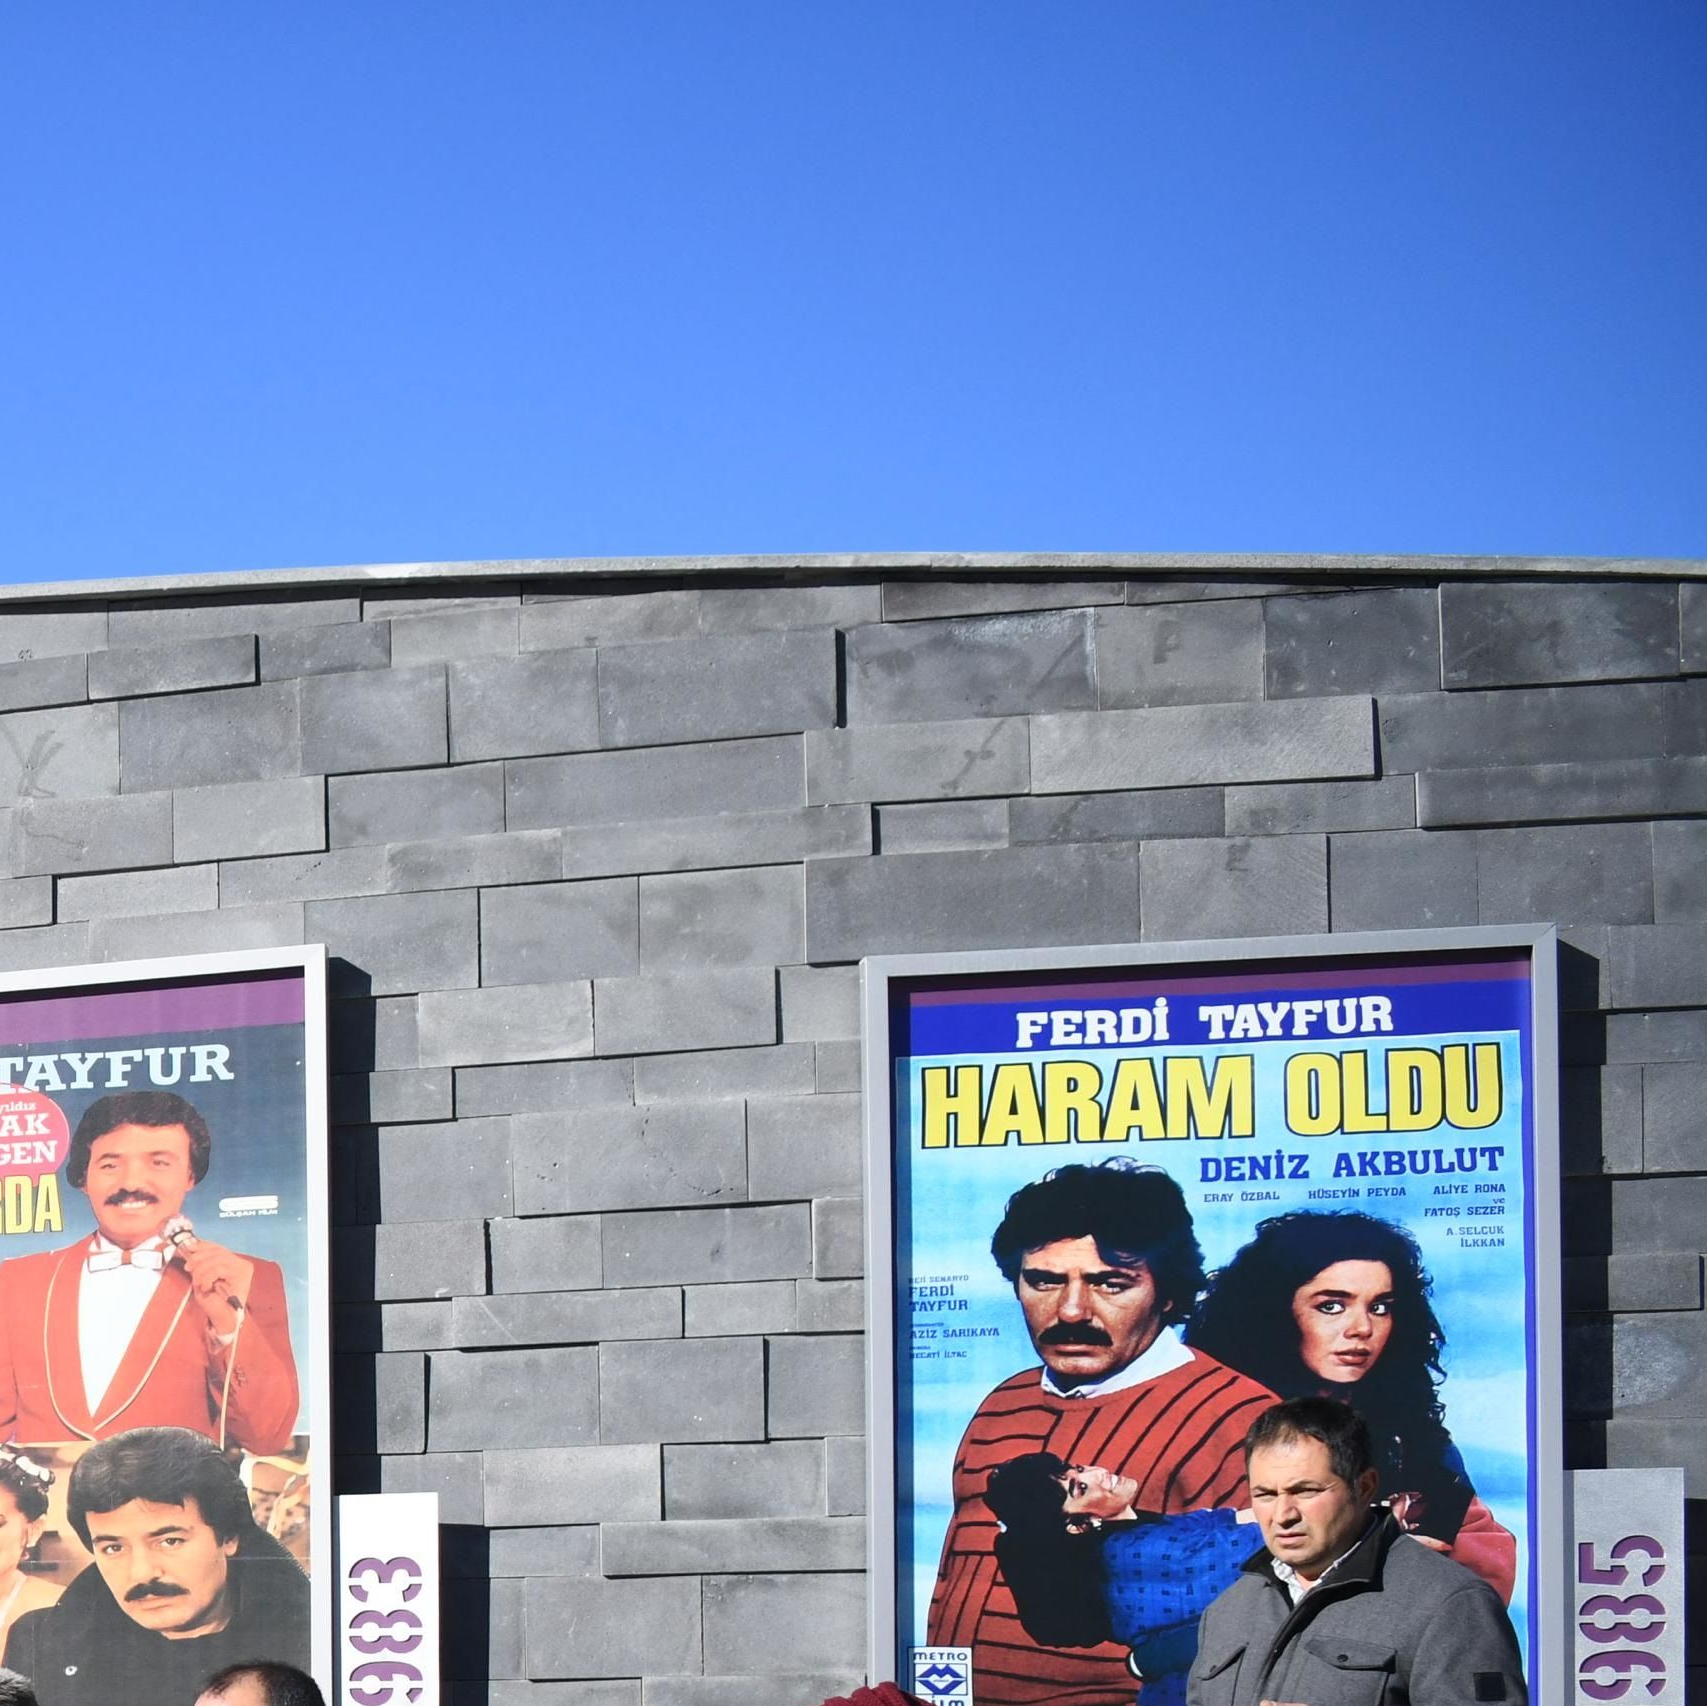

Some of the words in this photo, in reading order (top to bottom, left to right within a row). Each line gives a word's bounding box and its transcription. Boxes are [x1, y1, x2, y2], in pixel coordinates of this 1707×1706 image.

[1015, 997, 1170, 1048] FERDİ
[1198, 995, 1393, 1040] TAYFUR
[921, 1054, 1254, 1149] HARAM
[1286, 1042, 1503, 1137] OLDU
[1200, 1149, 1309, 1182] DENİZ
[1332, 1146, 1504, 1178] AKBULUT
[1204, 1192, 1234, 1203] ERAY
[1241, 1189, 1280, 1201] ÖZBAL
[1308, 1187, 1360, 1200] HÜSEYİN
[1367, 1187, 1407, 1198] PEYDA
[1433, 1183, 1468, 1195] ALİYE
[1475, 1183, 1506, 1194] RONA
[1424, 1206, 1460, 1218] FATOŞ
[1467, 1205, 1505, 1216] SEZER
[1460, 1237, 1505, 1248] İLKKAN
[908, 1284, 954, 1298] FERDİ
[908, 1300, 968, 1312] TAYFUR
[943, 1327, 1000, 1338] SARIKAYA
[913, 1652, 968, 1661] METRO
